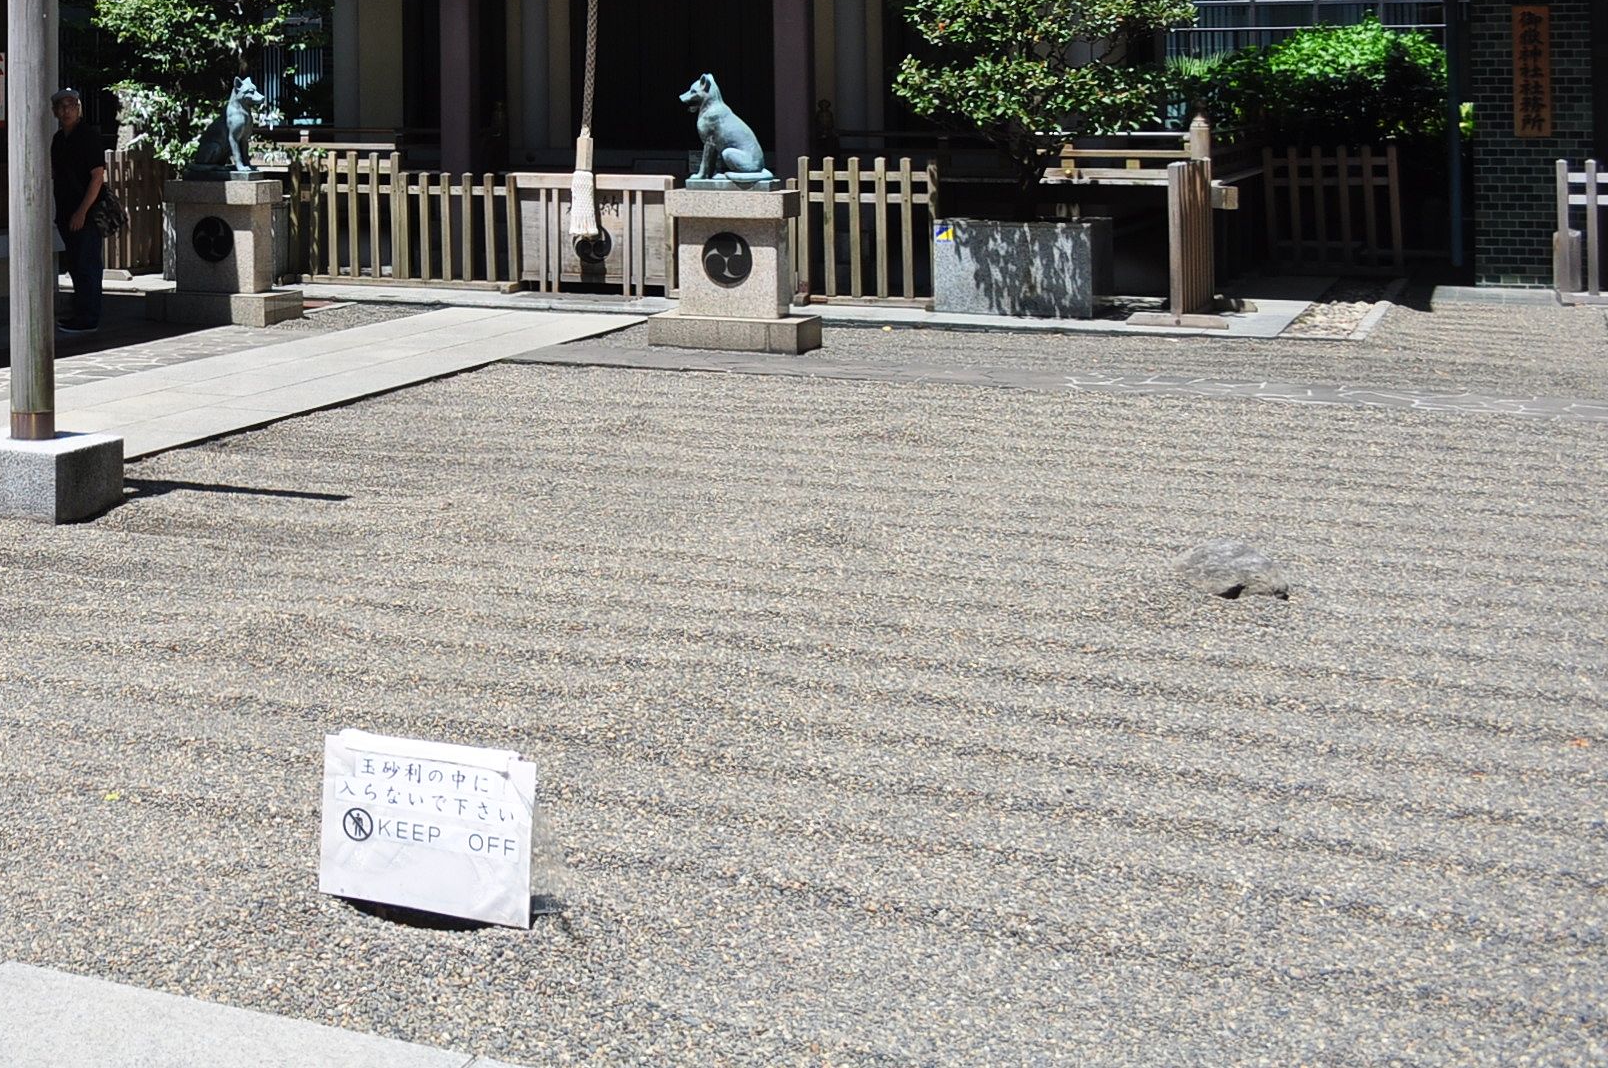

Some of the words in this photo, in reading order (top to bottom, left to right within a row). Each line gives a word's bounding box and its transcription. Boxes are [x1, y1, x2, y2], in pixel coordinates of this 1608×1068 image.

[361, 758, 489, 793] 玉砂利の中に
[340, 781, 514, 822] 入らないで下さい
[378, 818, 441, 843] KEEP
[468, 833, 516, 856] OFF
